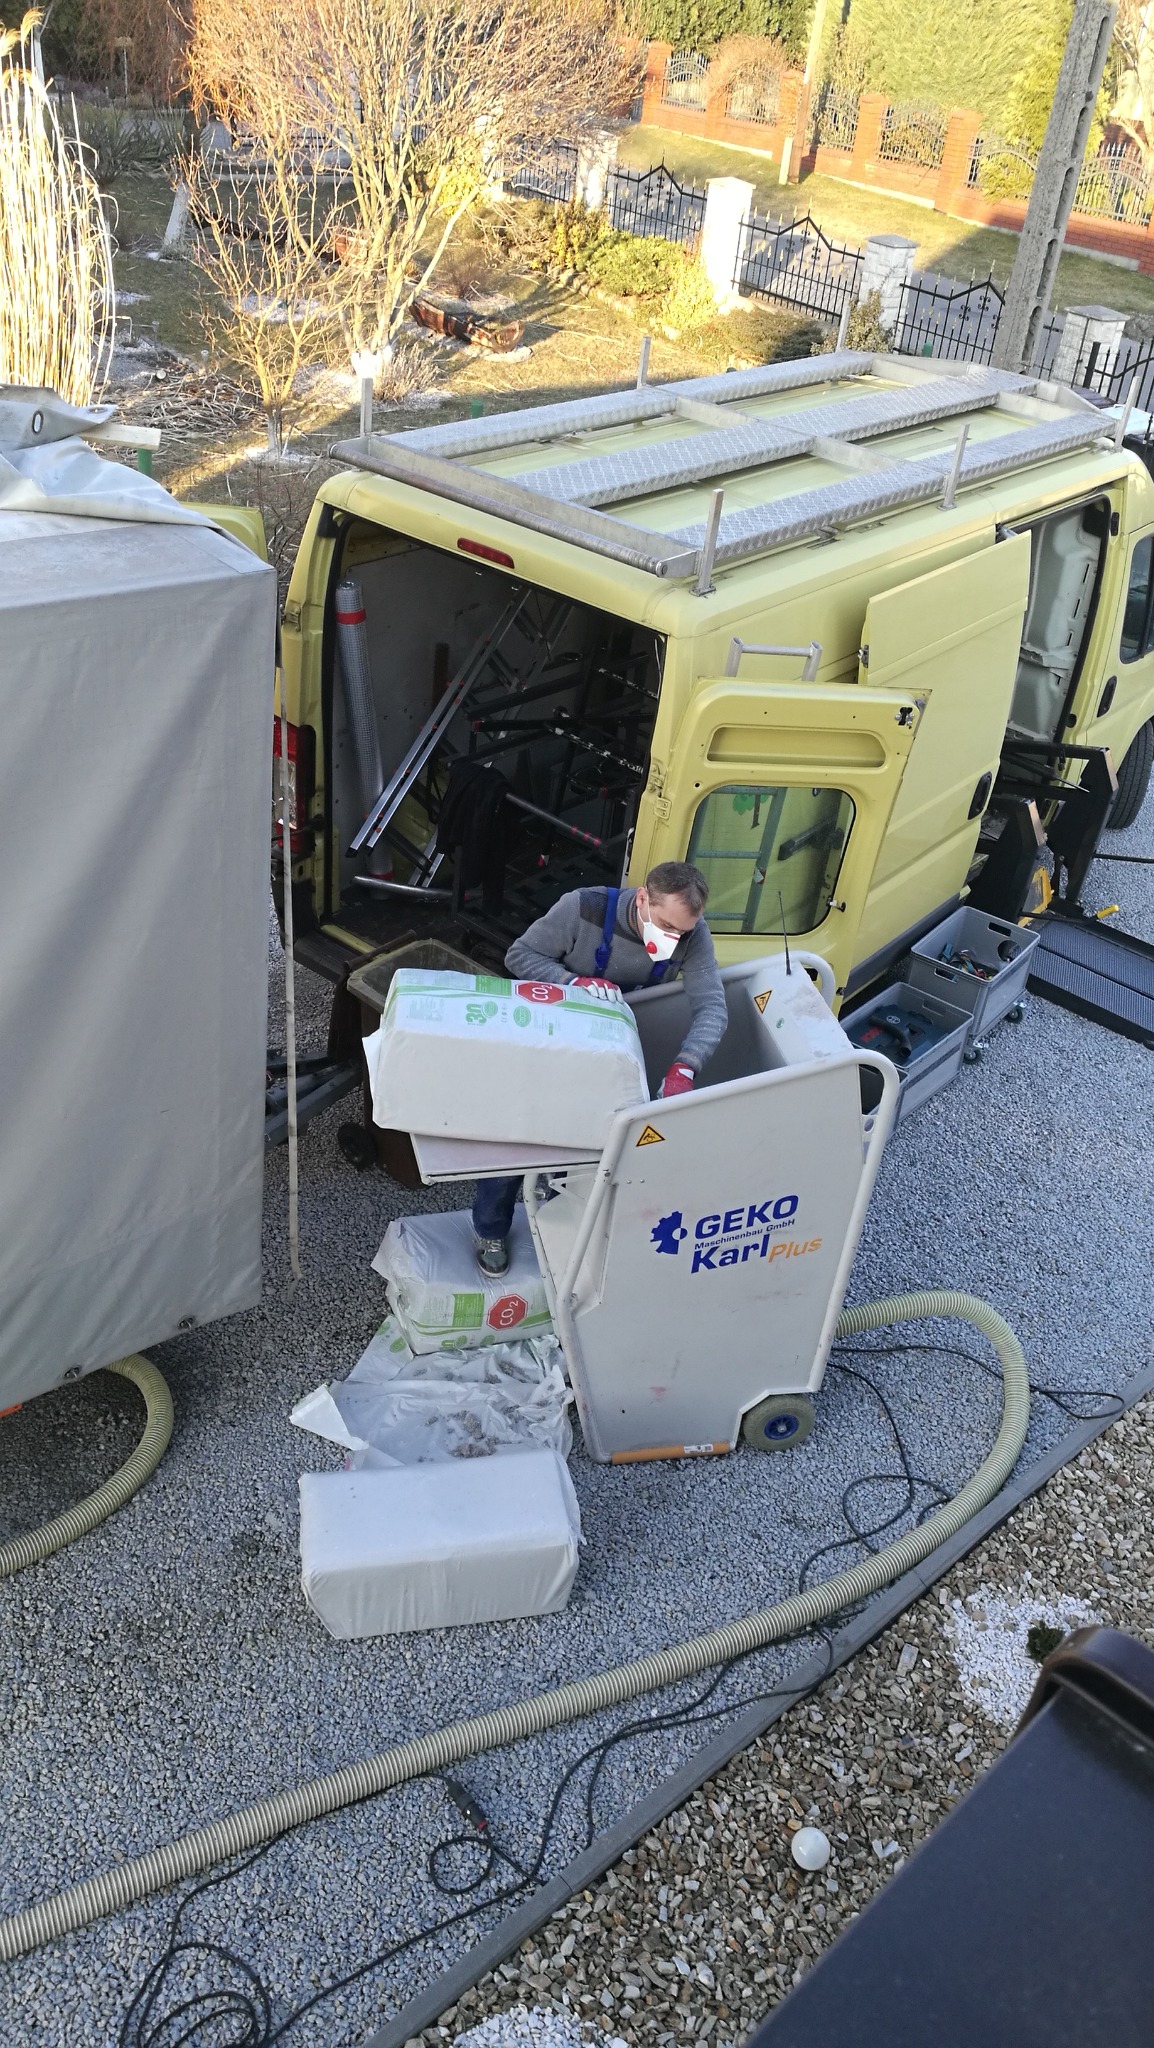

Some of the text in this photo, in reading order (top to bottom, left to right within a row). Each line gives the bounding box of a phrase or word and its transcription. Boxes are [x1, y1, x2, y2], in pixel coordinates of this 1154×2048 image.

[694, 1194, 799, 1240] GEKO
[694, 1218, 796, 1250] Maschinenbau GmbH
[691, 1233, 823, 1274] Karl Plus
